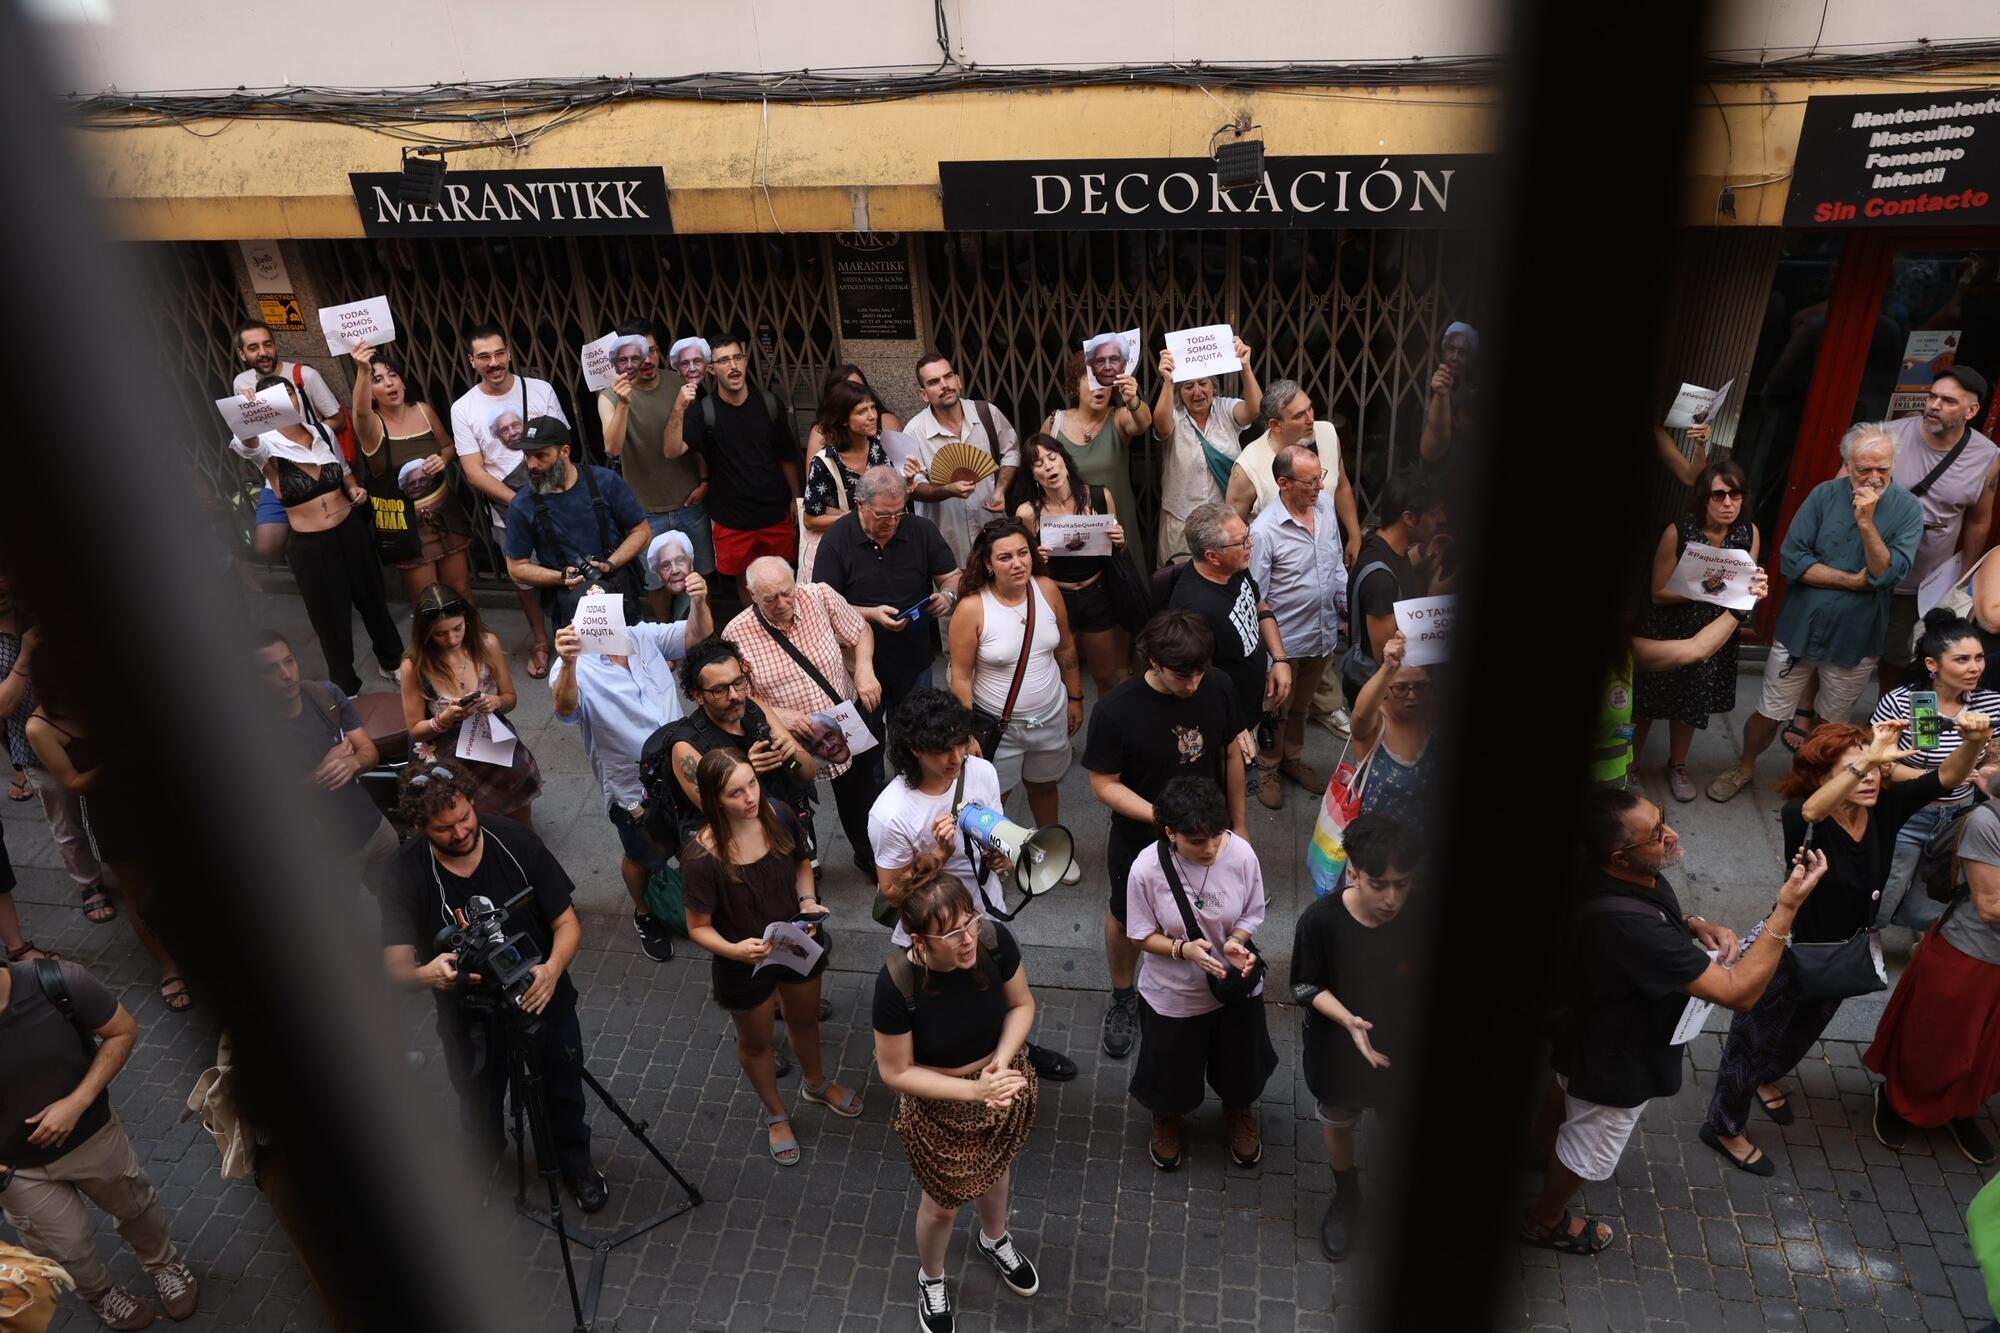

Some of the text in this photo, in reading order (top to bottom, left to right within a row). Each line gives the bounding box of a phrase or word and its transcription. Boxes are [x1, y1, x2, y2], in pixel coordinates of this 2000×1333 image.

[1869, 125, 1975, 148] Masculino
[1865, 147, 1965, 169] Femenino
[1872, 167, 1946, 189] Infantil
[1032, 157, 1456, 214] DECORACIÓN
[1813, 189, 1989, 223] Sin Contacto
[838, 261, 905, 271] MARANTIKK
[339, 308, 369, 320] TODAS
[341, 317, 373, 329] SOMOS
[341, 325, 378, 338] PAQUITA
[1187, 334, 1215, 345] TODAS
[1187, 343, 1218, 354] SOMOS
[1185, 352, 1223, 364] PAQUITA
[238, 398, 267, 410] TODAS
[242, 405, 273, 418] SOMOS
[243, 411, 281, 425] PAQUITA
[586, 605, 606, 613] TODAS
[1407, 610, 1424, 620] YO
[583, 617, 608, 625] SOMOS
[580, 628, 614, 638] PAQUITA
[990, 834, 1001, 848] NO
